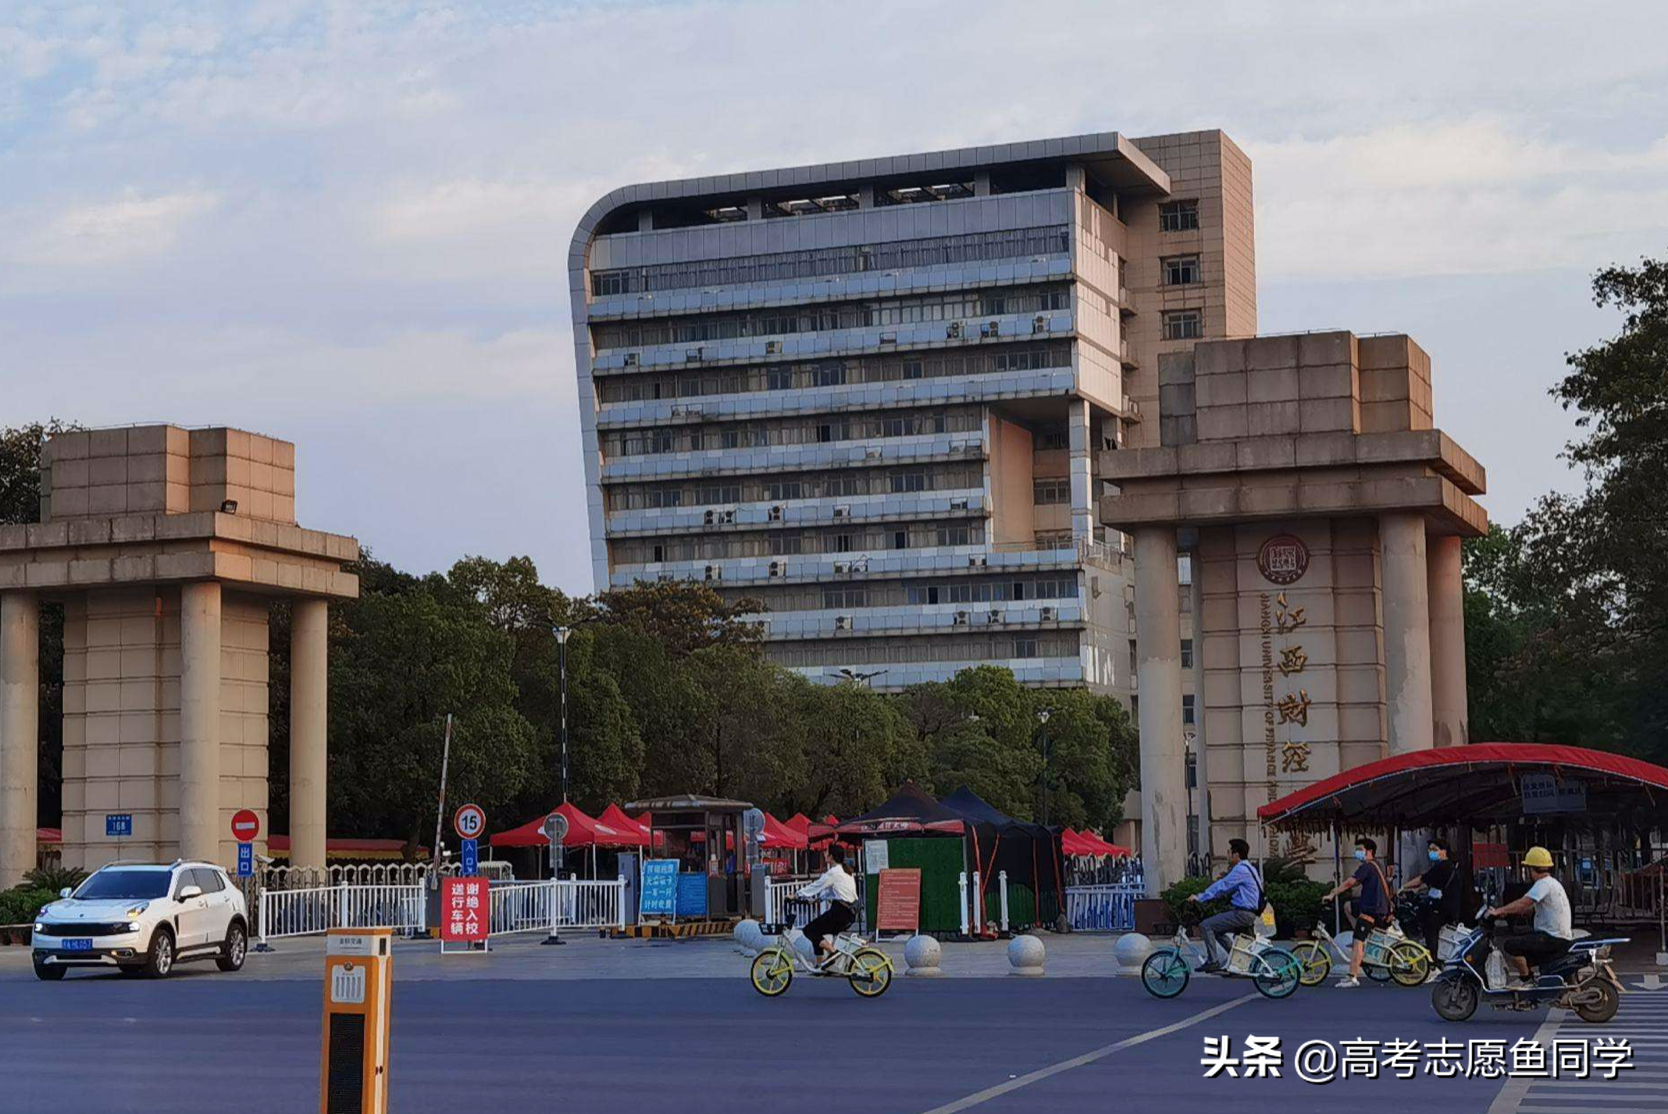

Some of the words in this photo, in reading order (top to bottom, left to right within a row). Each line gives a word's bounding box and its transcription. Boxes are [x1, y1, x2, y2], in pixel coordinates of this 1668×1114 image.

[1260, 593, 1272, 639] JIANGXI
[1261, 641, 1274, 708] UNIVERSITY
[1265, 711, 1275, 726] OF
[1265, 727, 1277, 777] FINANCE
[461, 815, 477, 830] 15
[240, 847, 250, 871] 出口
[465, 842, 474, 866] 入口
[450, 883, 464, 934] 送行车辆
[465, 883, 479, 934] 谢绝入校
